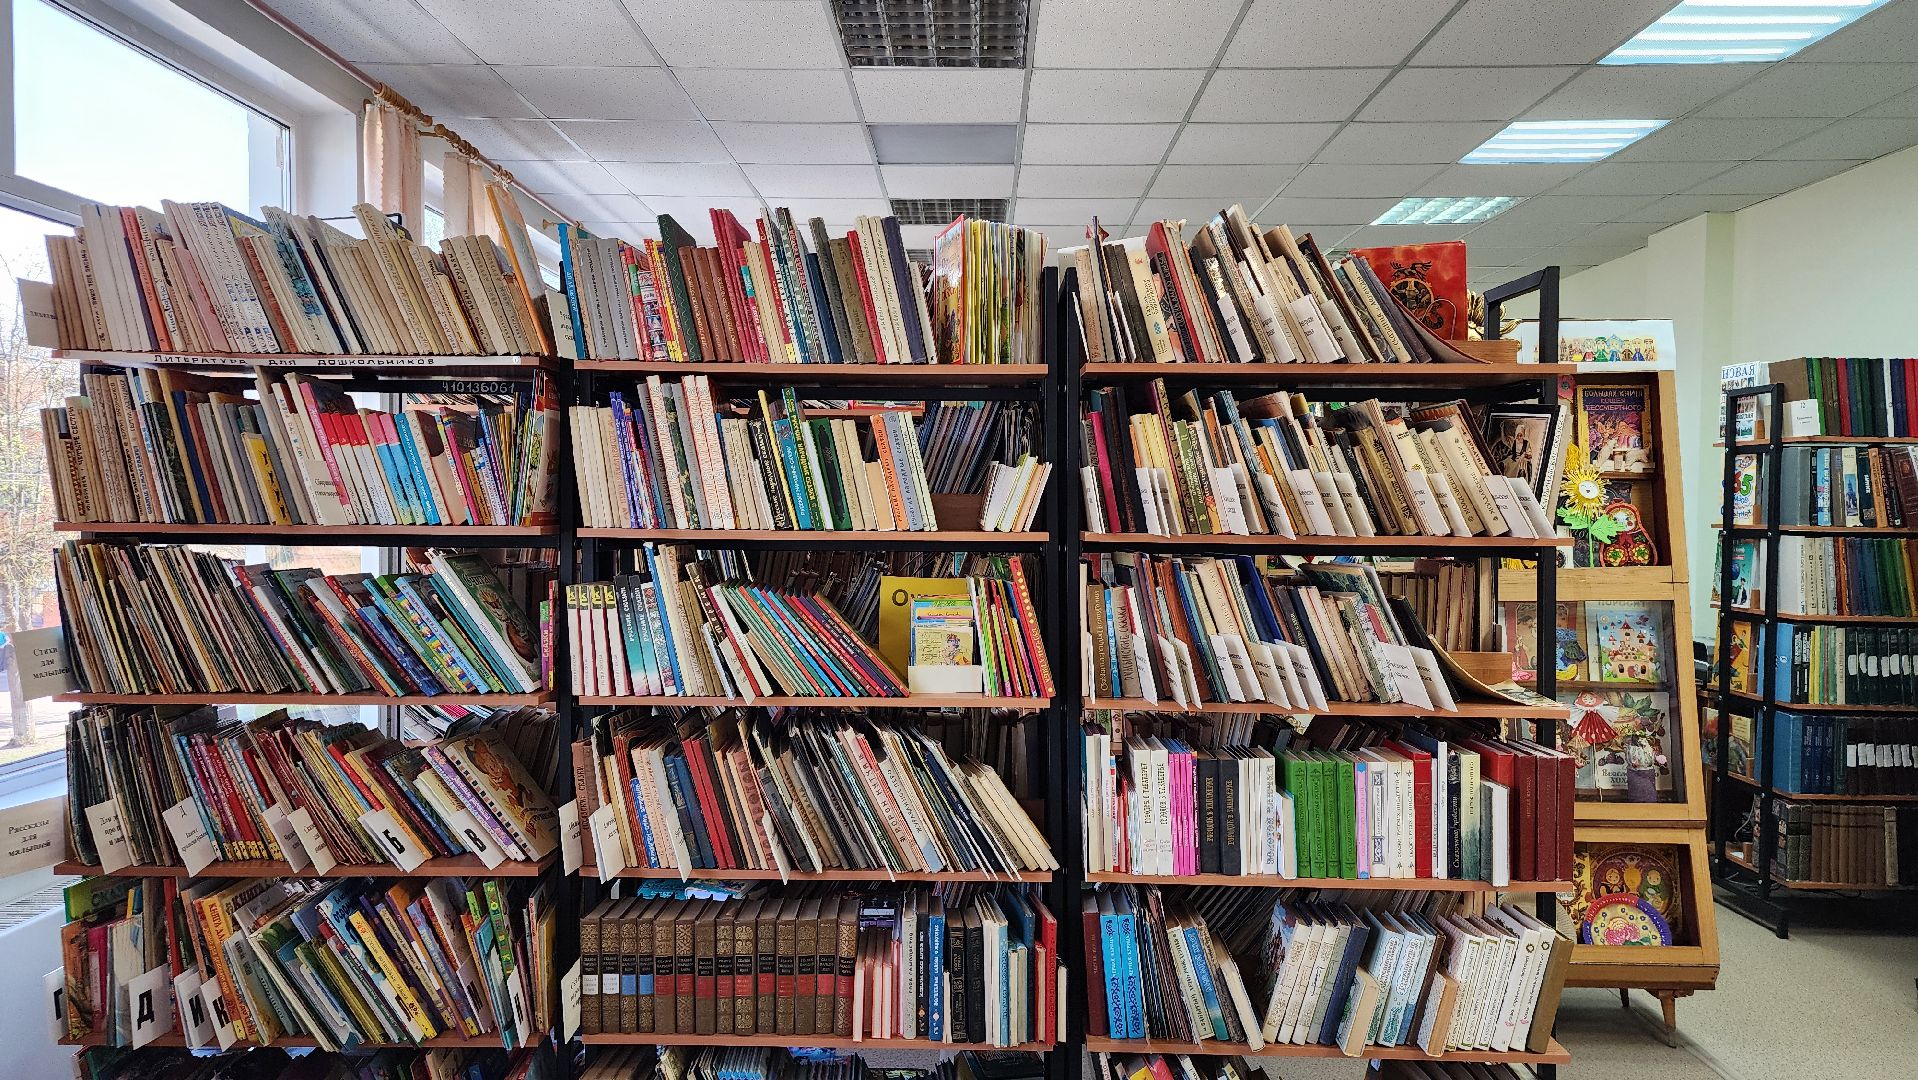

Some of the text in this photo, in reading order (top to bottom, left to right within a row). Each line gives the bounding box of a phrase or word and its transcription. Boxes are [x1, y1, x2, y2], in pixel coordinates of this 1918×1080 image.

[73, 434, 84, 465] ЧЕТЫРЕ
[382, 828, 406, 854] Б
[463, 828, 487, 853] В
[208, 902, 223, 927] КНИГА
[137, 989, 155, 1031] Д
[212, 995, 230, 1029] К
